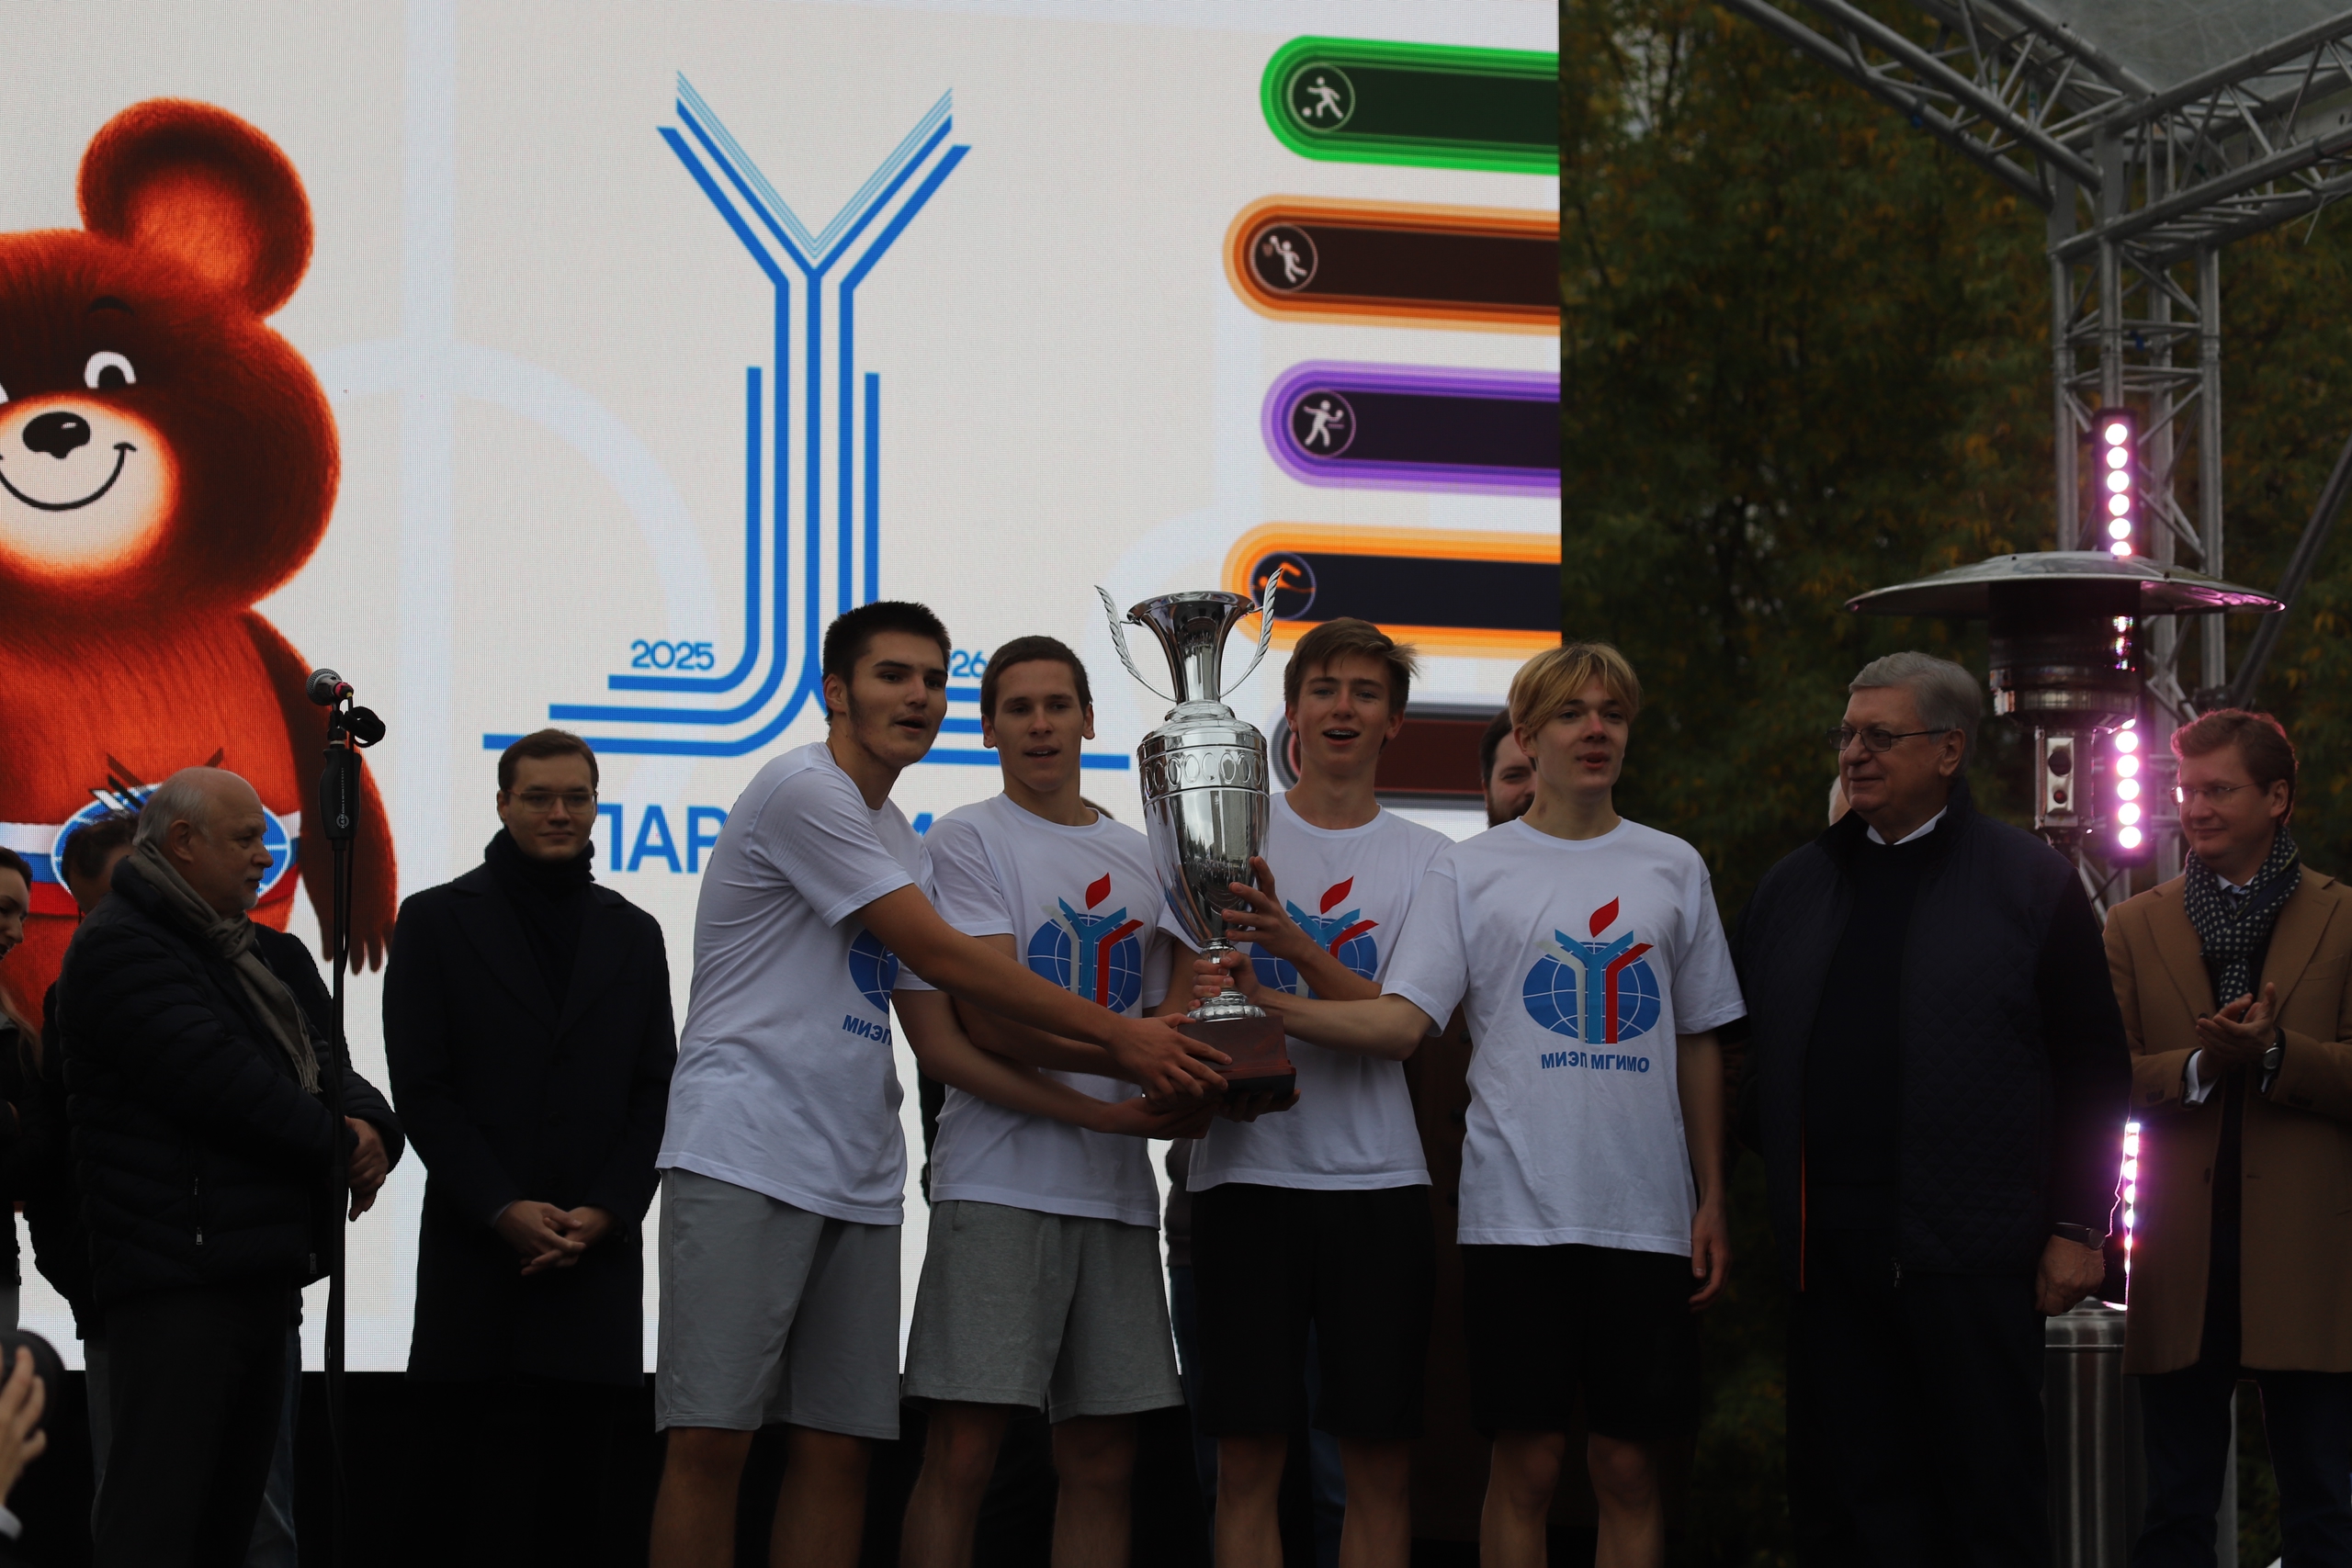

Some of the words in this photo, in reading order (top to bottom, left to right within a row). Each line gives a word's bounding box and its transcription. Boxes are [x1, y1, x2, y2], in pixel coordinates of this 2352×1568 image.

[630, 639, 715, 671] 2025
[948, 649, 989, 678] 26
[842, 1014, 892, 1046] МИЭП
[1541, 1051, 1588, 1069] МИЭП
[1590, 1054, 1650, 1073] МГИМО
